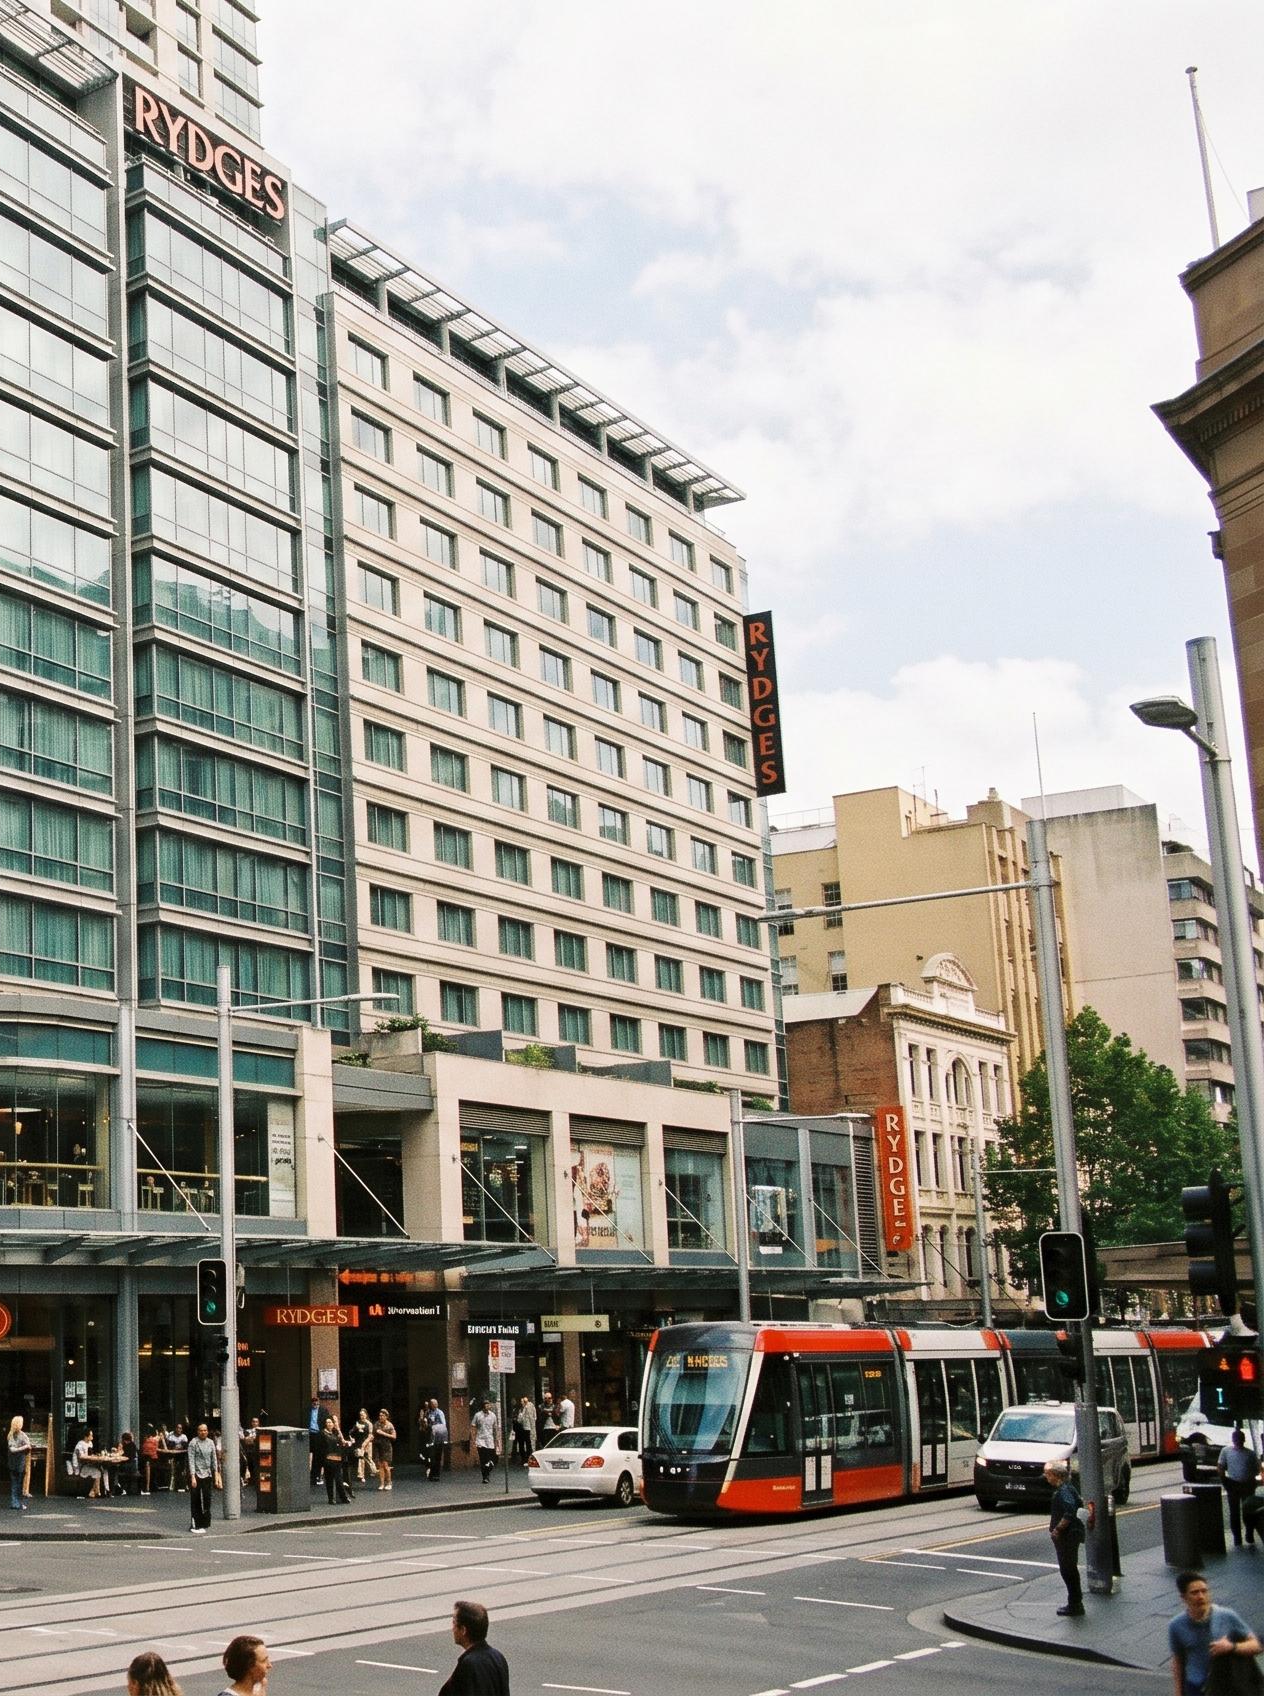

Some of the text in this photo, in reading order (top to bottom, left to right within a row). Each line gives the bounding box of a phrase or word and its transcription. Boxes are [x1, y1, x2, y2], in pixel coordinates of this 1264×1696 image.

[134, 85, 285, 220] RYDGES
[748, 621, 778, 784] RYDGES
[277, 1309, 348, 1324] RYDGES
